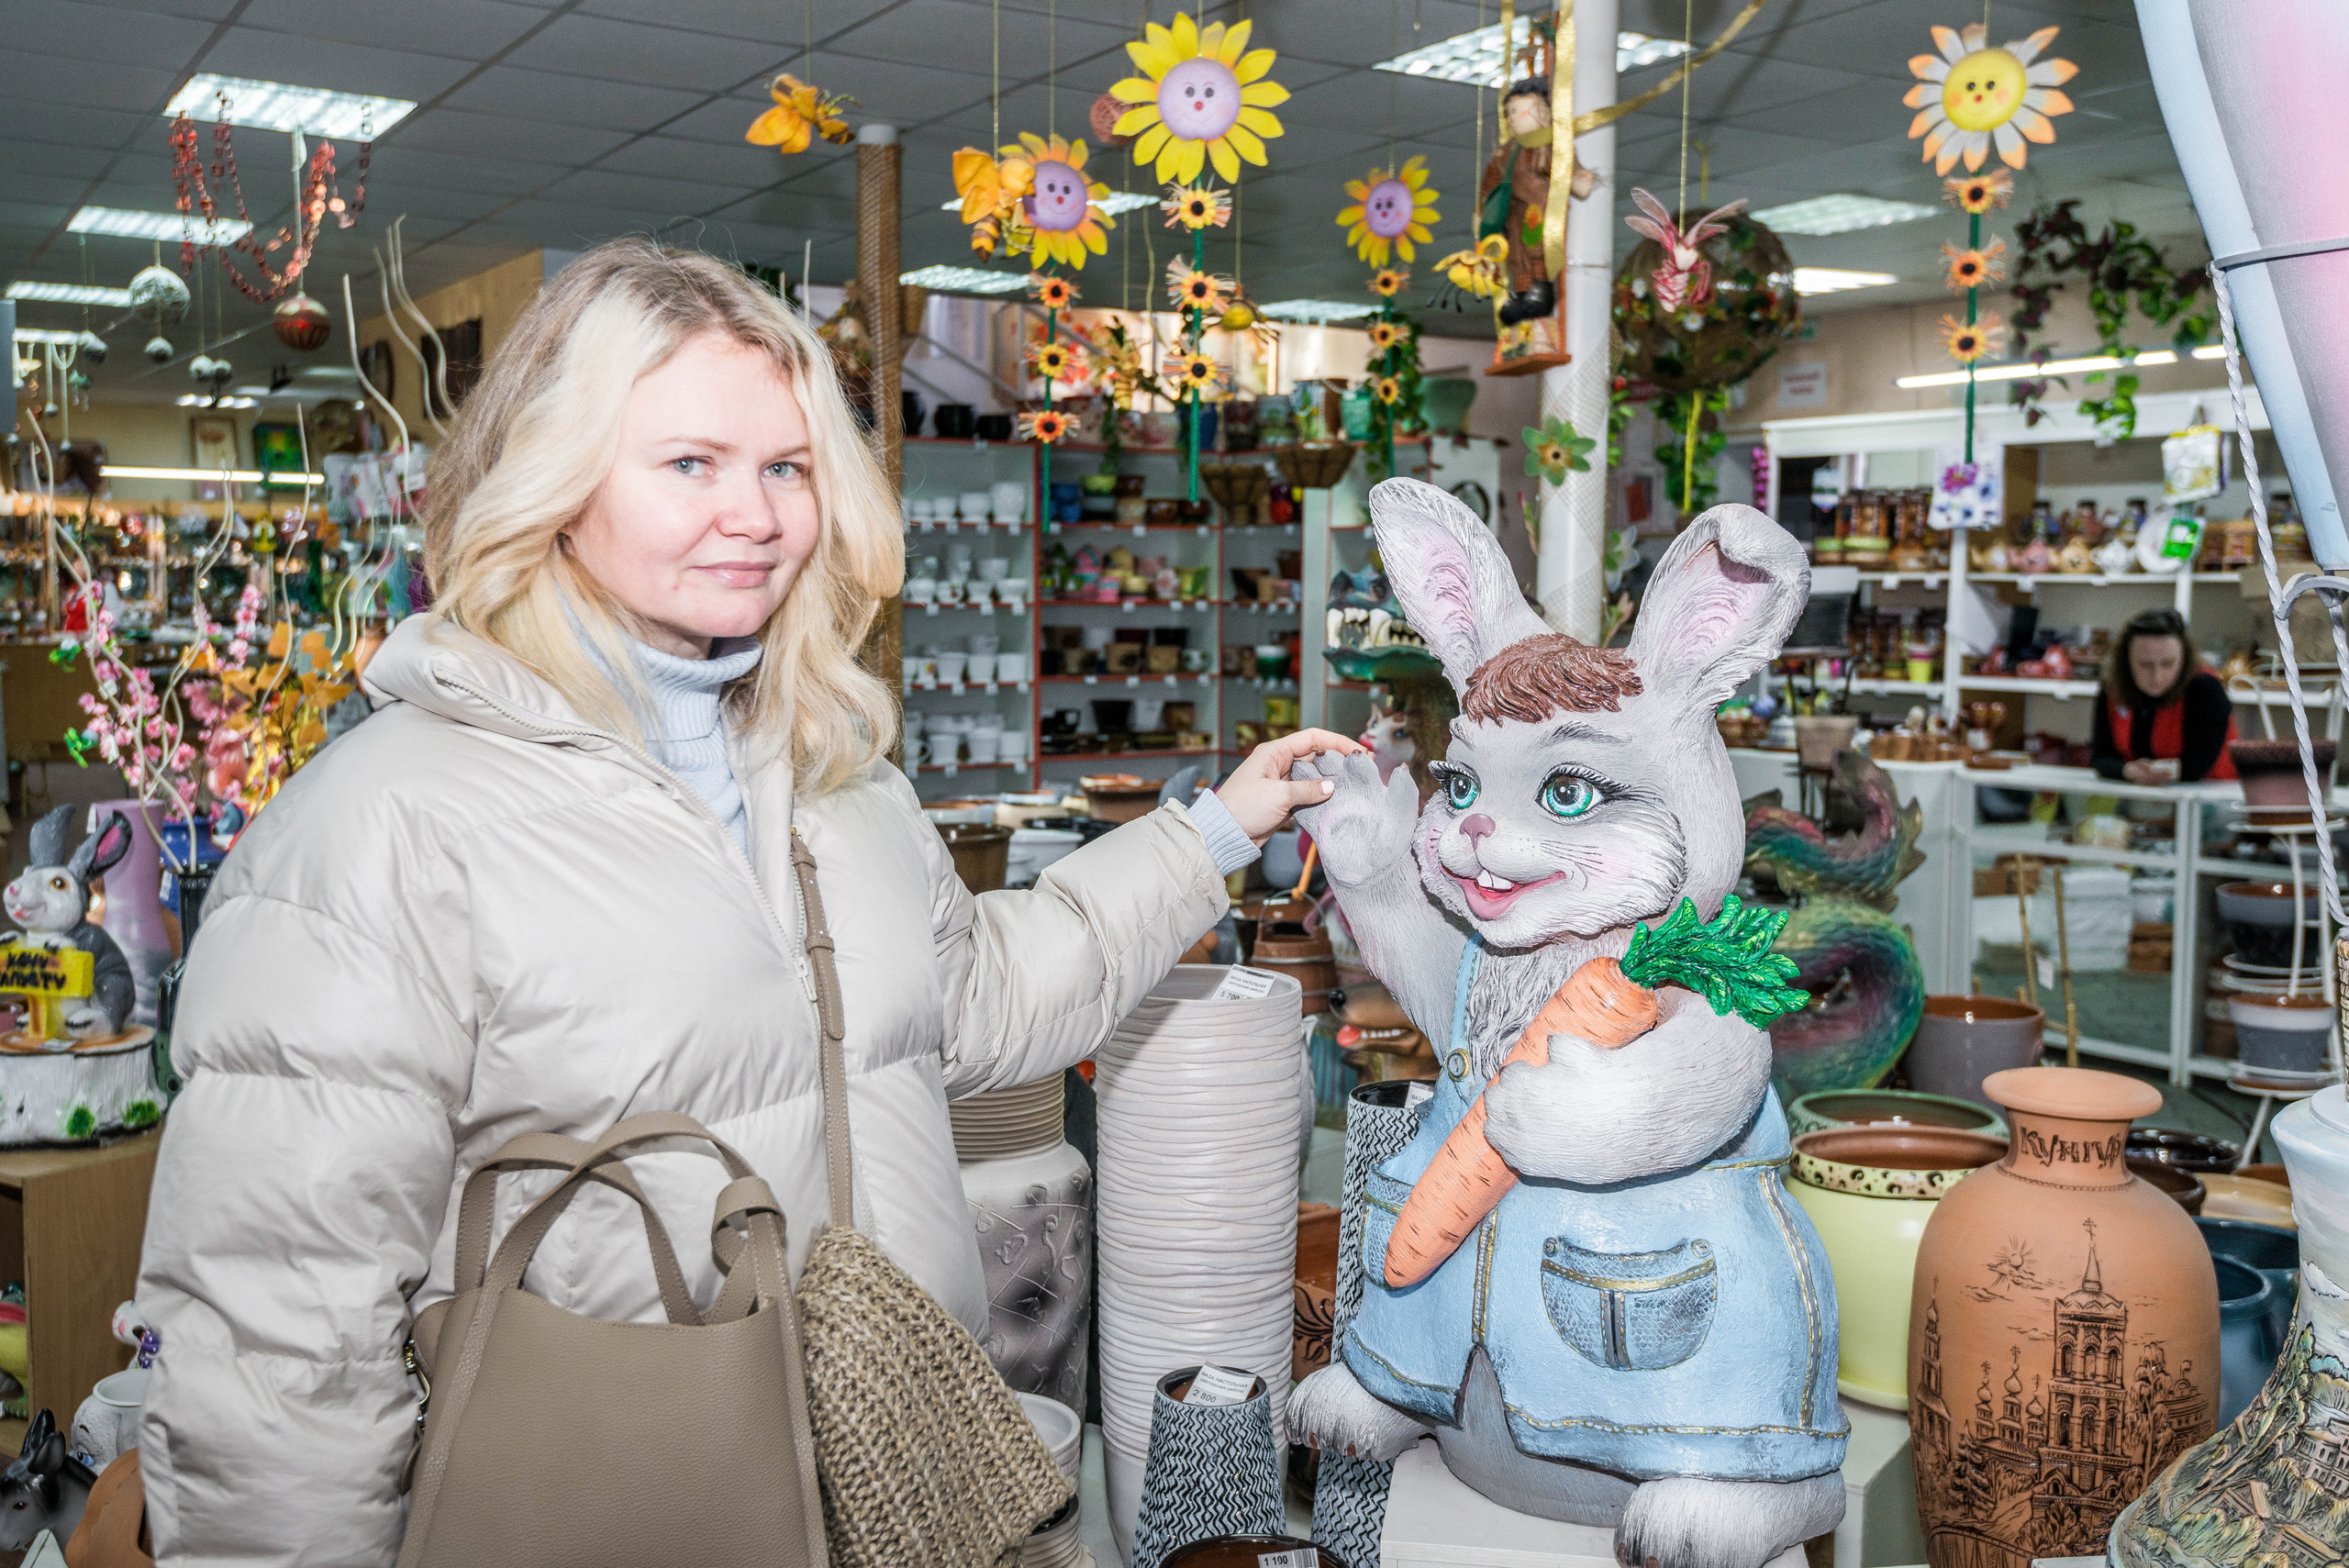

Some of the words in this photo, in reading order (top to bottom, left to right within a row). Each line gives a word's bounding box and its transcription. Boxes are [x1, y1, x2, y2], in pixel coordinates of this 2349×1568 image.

[1201, 1371, 1215, 1380] ВАЗА
[1215, 1377, 1249, 1388] НАСТОЛЬНАЯ
[1200, 1392, 1217, 1403] 800
[1264, 1557, 1269, 1566] 1
[1272, 1554, 1288, 1565] 100
